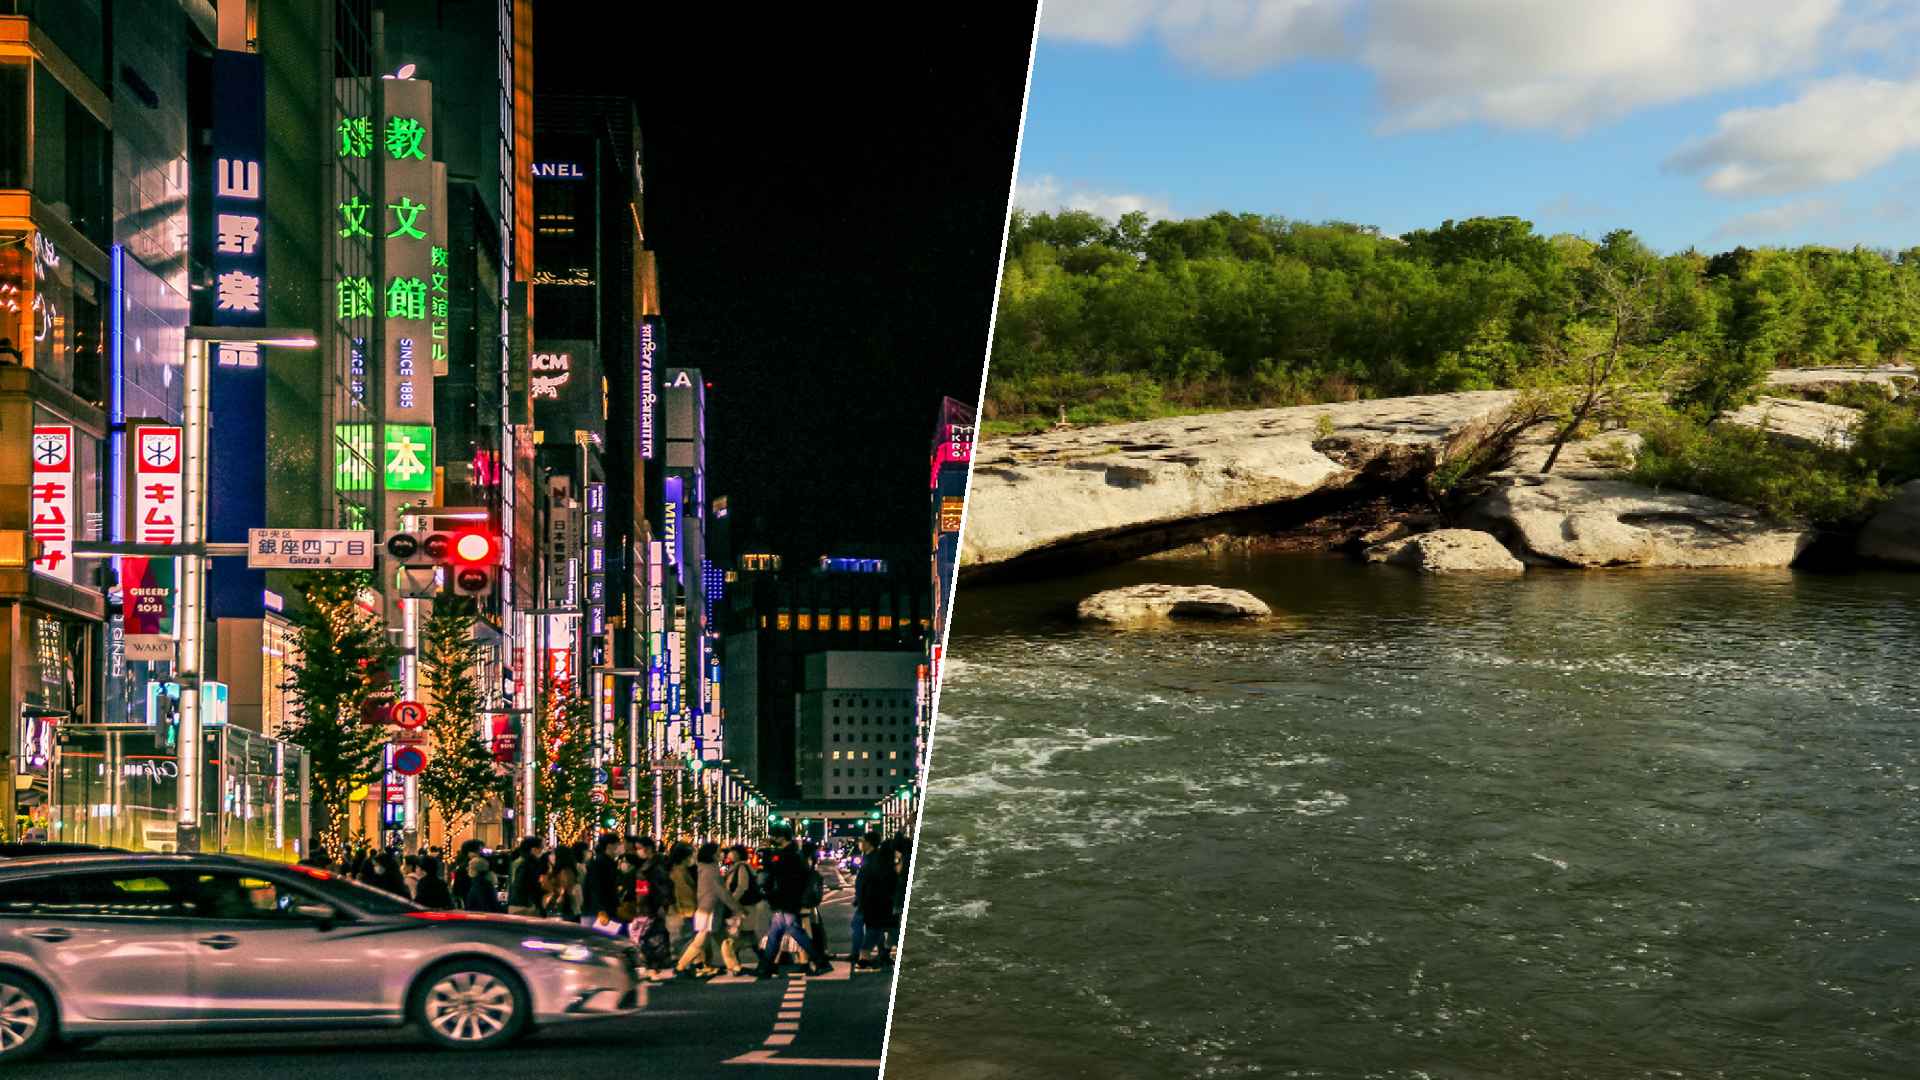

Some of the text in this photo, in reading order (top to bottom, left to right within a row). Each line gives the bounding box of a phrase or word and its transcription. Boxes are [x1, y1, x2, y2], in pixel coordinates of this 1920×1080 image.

[384, 116, 427, 320] 教文館
[400, 338, 414, 408] SINCE 1885
[387, 435, 426, 481] 本
[258, 539, 364, 556] 銀座四丁目
[289, 556, 320, 564] Ginza
[130, 588, 169, 596] CHEERS
[137, 604, 162, 612] 2021
[133, 643, 168, 651] WAKO
